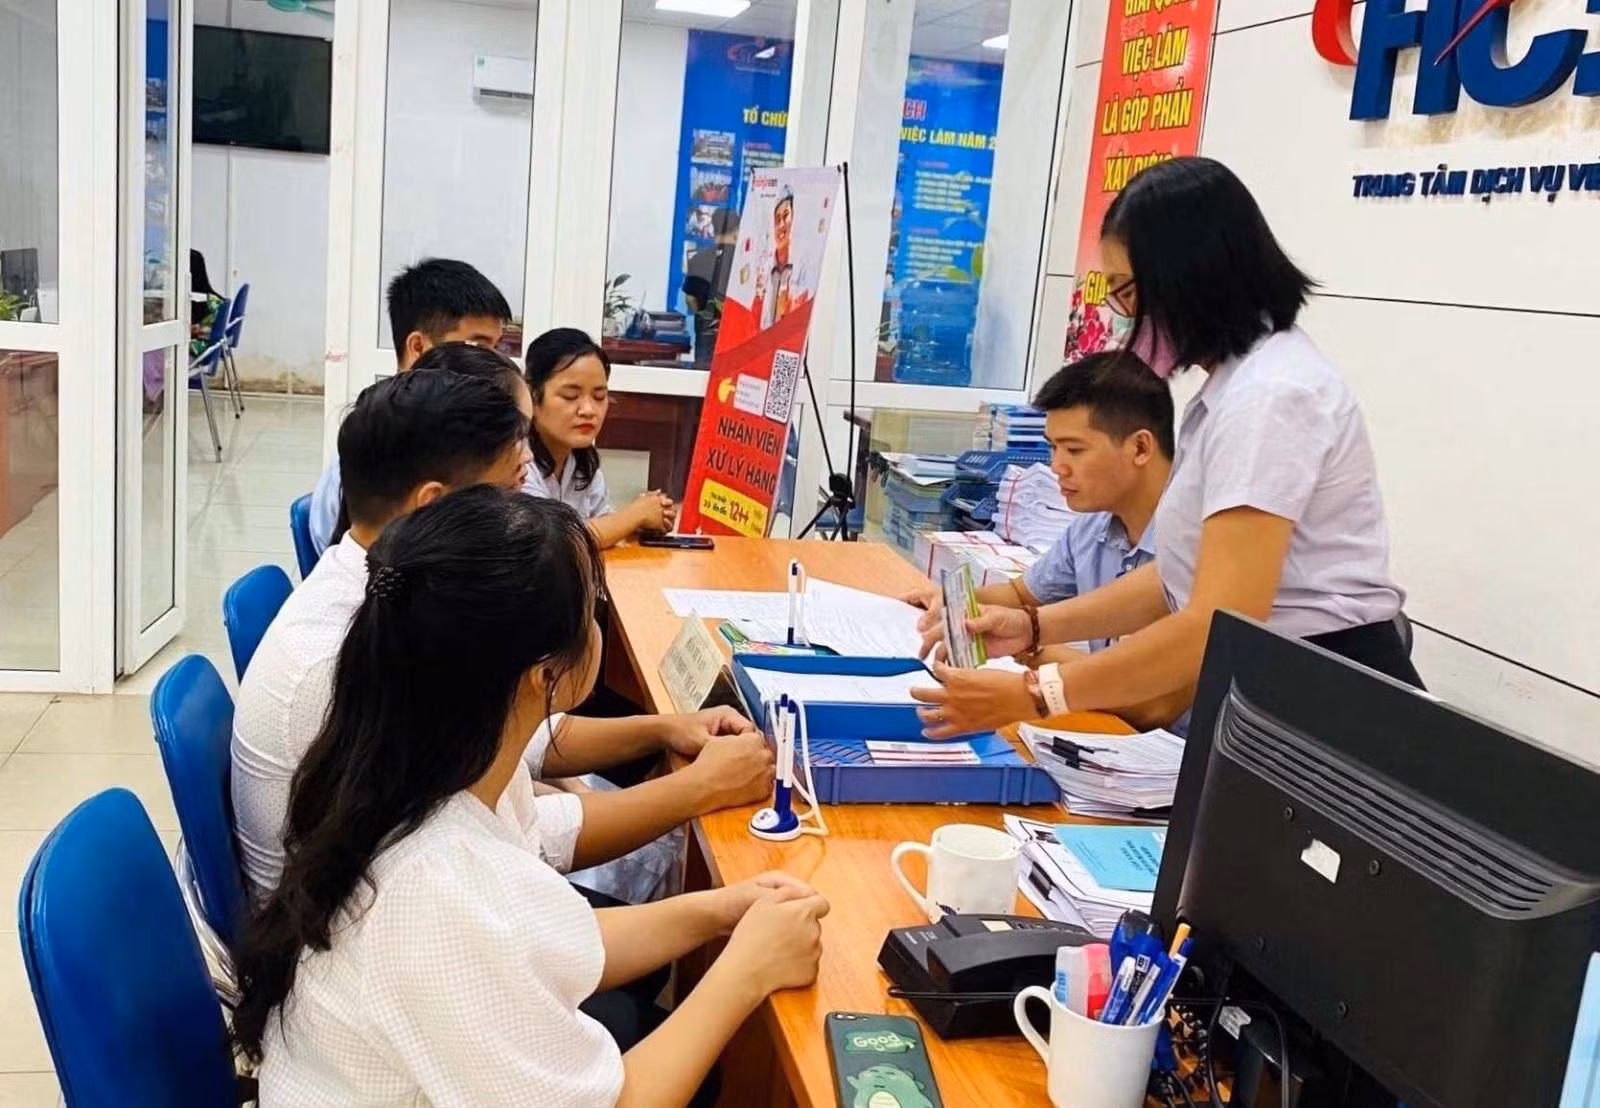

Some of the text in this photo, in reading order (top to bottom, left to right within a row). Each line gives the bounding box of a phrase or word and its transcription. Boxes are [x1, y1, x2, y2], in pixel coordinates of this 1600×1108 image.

[1122, 22, 1190, 82] VIỆC LÀM
[743, 104, 759, 125] TỔ
[900, 125, 927, 144] VIỆC
[1102, 77, 1194, 136] LÀ GÓP PHẦN
[1352, 172, 1416, 198] TRUNG
[1419, 163, 1468, 197] TÂM
[1470, 167, 1526, 204] DỊCH
[1529, 165, 1566, 203] VỤ
[717, 416, 782, 457] NHÂN VIÊN
[706, 444, 729, 472] XỬ
[728, 454, 745, 479] LÝ
[853, 1031, 901, 1048] Good
